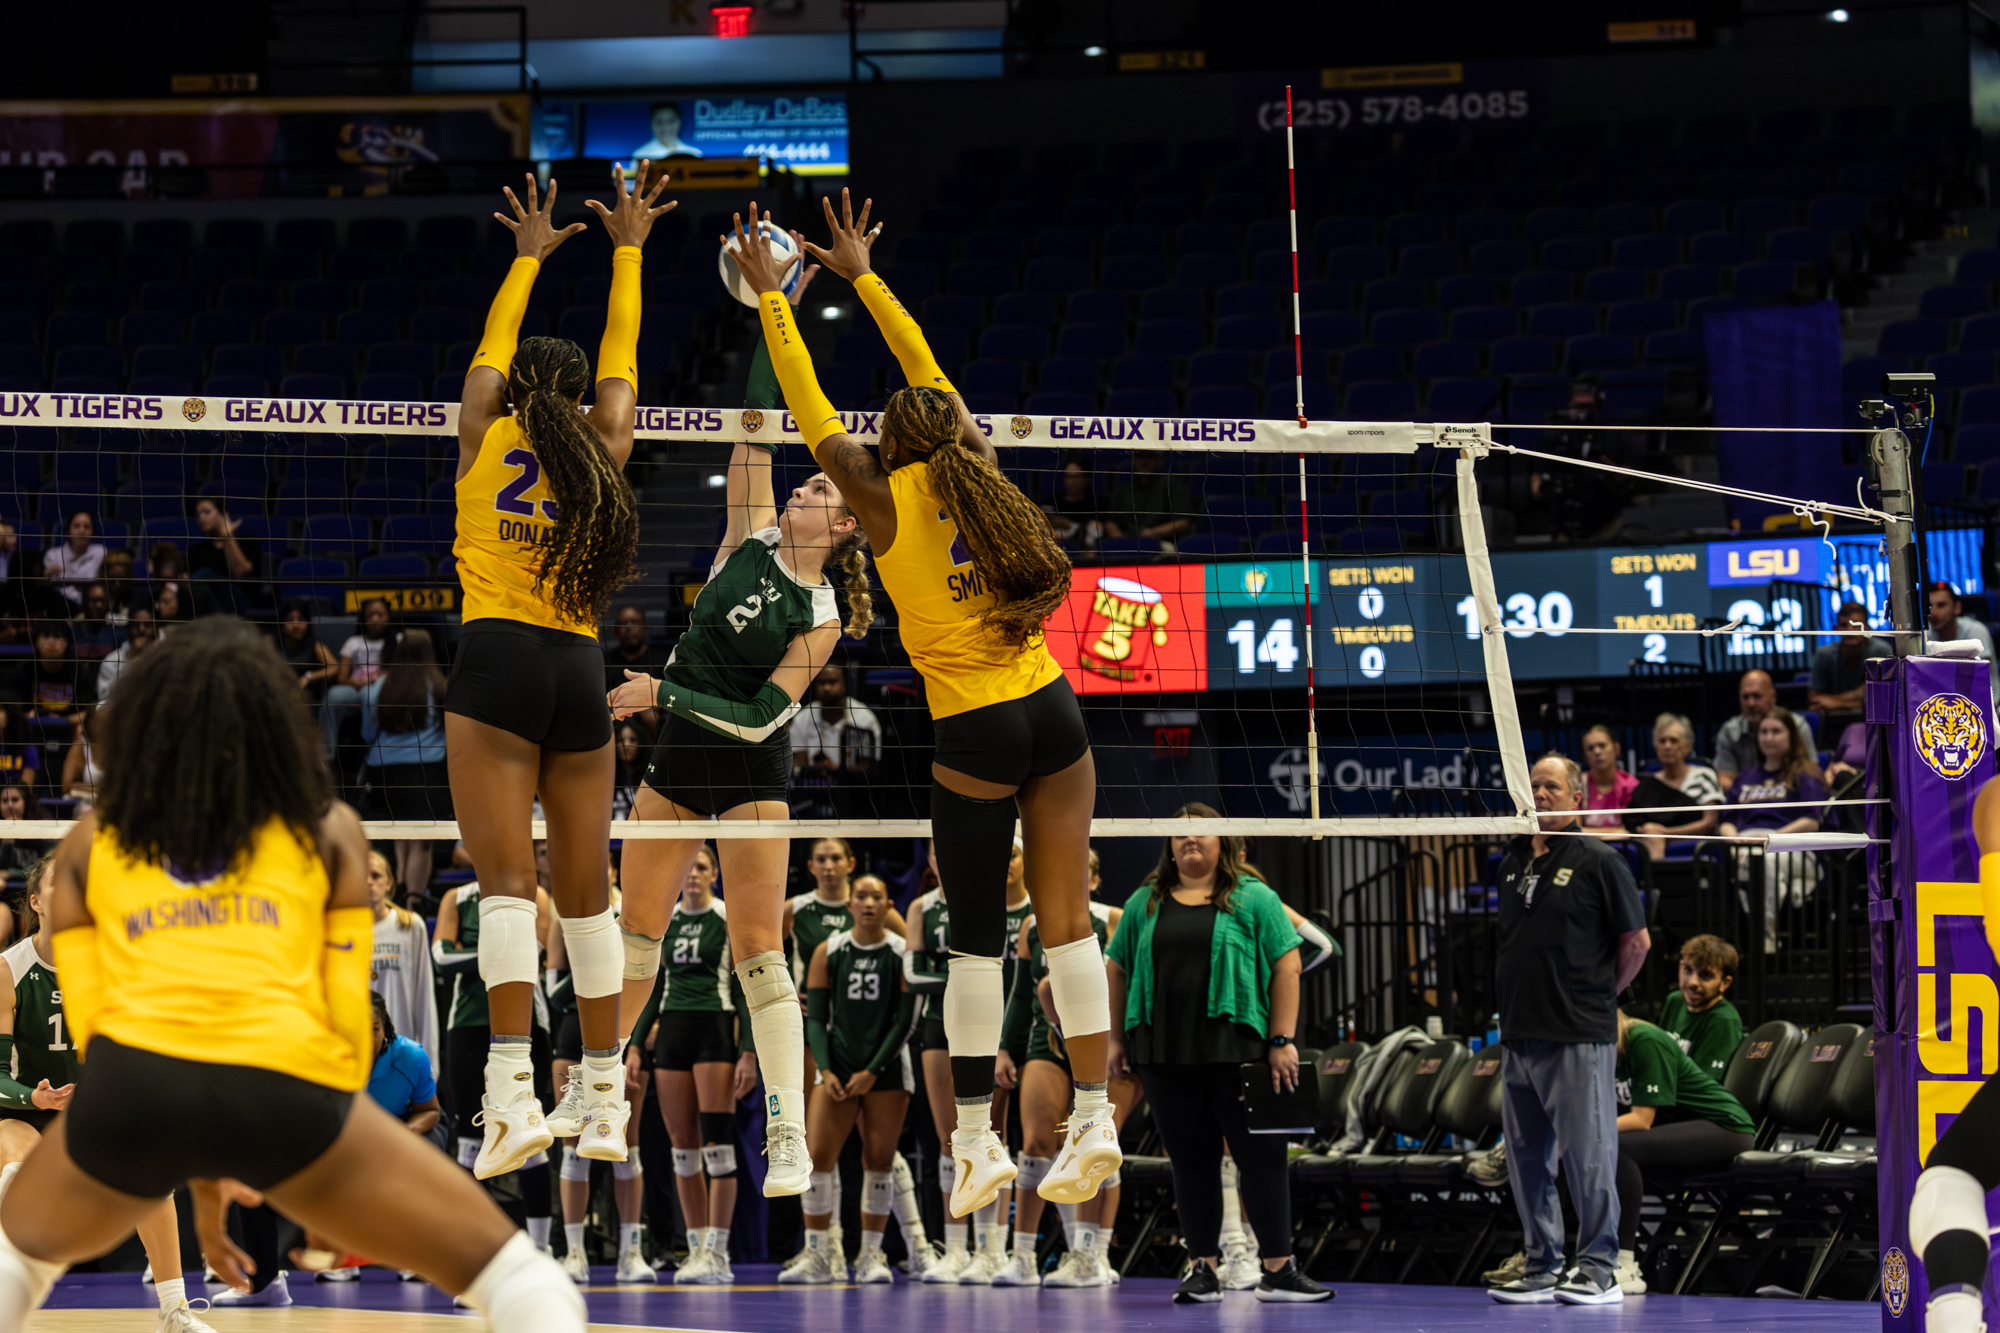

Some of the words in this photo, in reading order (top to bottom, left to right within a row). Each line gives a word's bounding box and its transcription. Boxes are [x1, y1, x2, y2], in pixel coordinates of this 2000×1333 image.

[1257, 98, 1351, 133] (225)
[1360, 89, 1530, 126] 578-4085
[770, 299, 792, 345] TIGERS
[50, 395, 163, 420] TIGERS
[225, 399, 327, 424] GEAUX
[336, 402, 447, 427] TIGERS
[634, 408, 723, 431] IGERS
[782, 411, 879, 435] GUX
[1050, 417, 1144, 440] GEAUX
[1152, 419, 1256, 442] TIGERS
[499, 518, 551, 545] DONA
[1328, 567, 1371, 586] SETS
[1374, 566, 1415, 584] WON
[1611, 555, 1652, 574] SETS
[1655, 553, 1697, 572] WON
[1727, 548, 1800, 578] LSU
[947, 569, 992, 603] SMI
[1644, 574, 1663, 608] 1
[726, 594, 762, 634] 2
[1093, 589, 1151, 628] TAKE
[1358, 586, 1385, 619] 0
[1331, 624, 1414, 644] TIMEOUTS
[1613, 612, 1696, 631] TIMEOUTS
[1093, 620, 1134, 661] 5
[1227, 618, 1299, 674] 14
[1643, 634, 1667, 664] 2
[1359, 646, 1386, 678] 0
[1334, 759, 1398, 792] Our
[1553, 867, 1574, 887] S
[125, 892, 280, 941] WASHINGTON
[673, 937, 702, 963] 21
[847, 971, 880, 1000] 23
[1079, 1120, 1094, 1134] LSU
